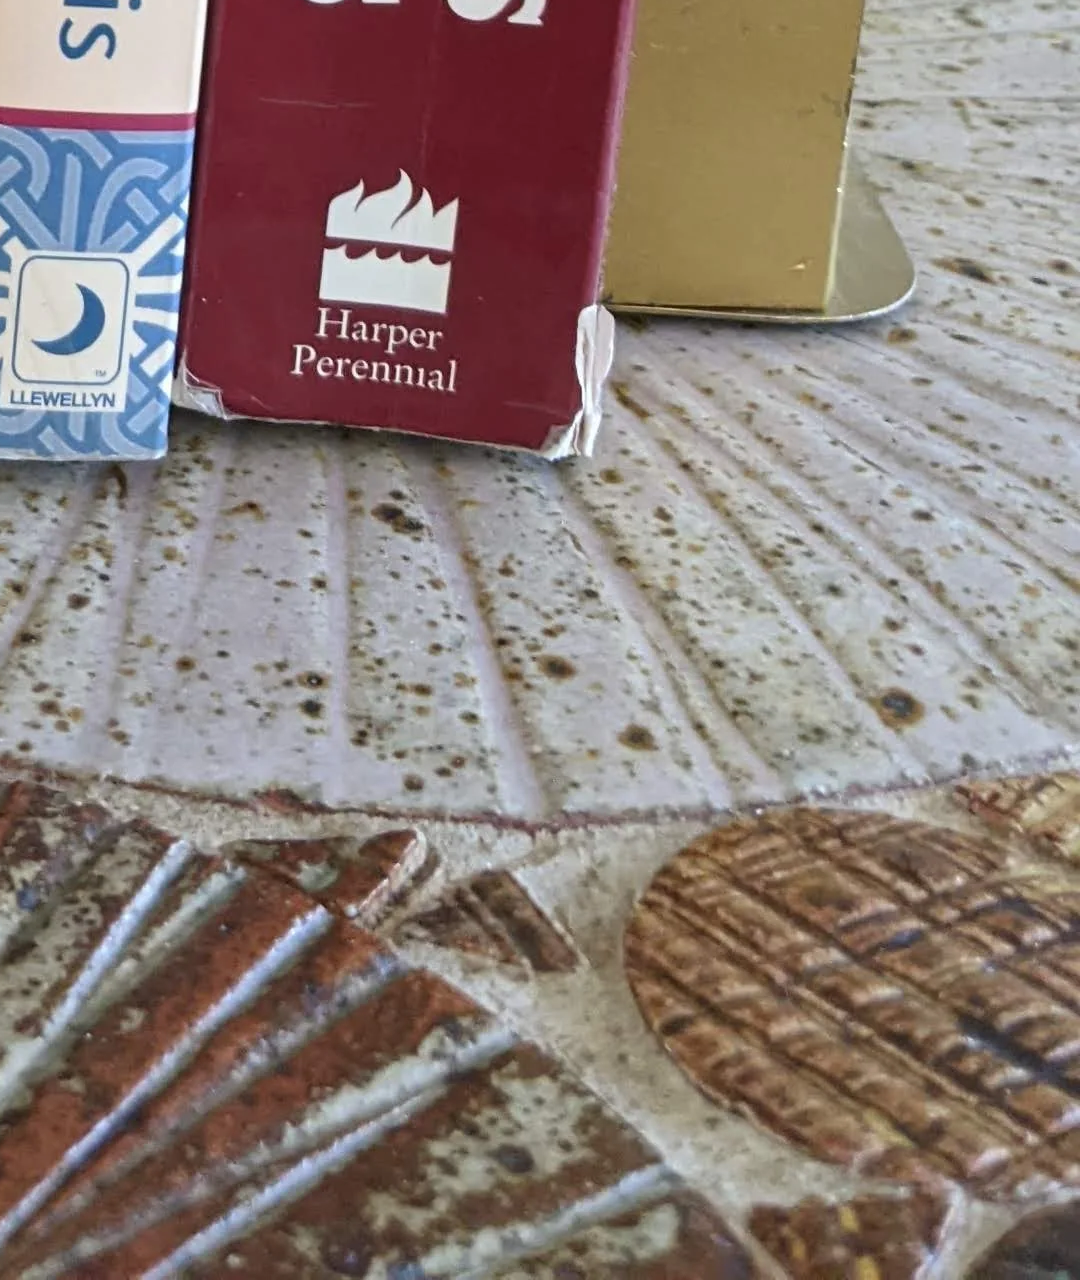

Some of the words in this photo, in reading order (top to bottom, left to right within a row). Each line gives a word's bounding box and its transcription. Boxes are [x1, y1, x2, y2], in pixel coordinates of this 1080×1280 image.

[314, 306, 445, 355] Harper
[289, 343, 460, 393] Perennial
[9, 389, 117, 408] LLEWELLYN
